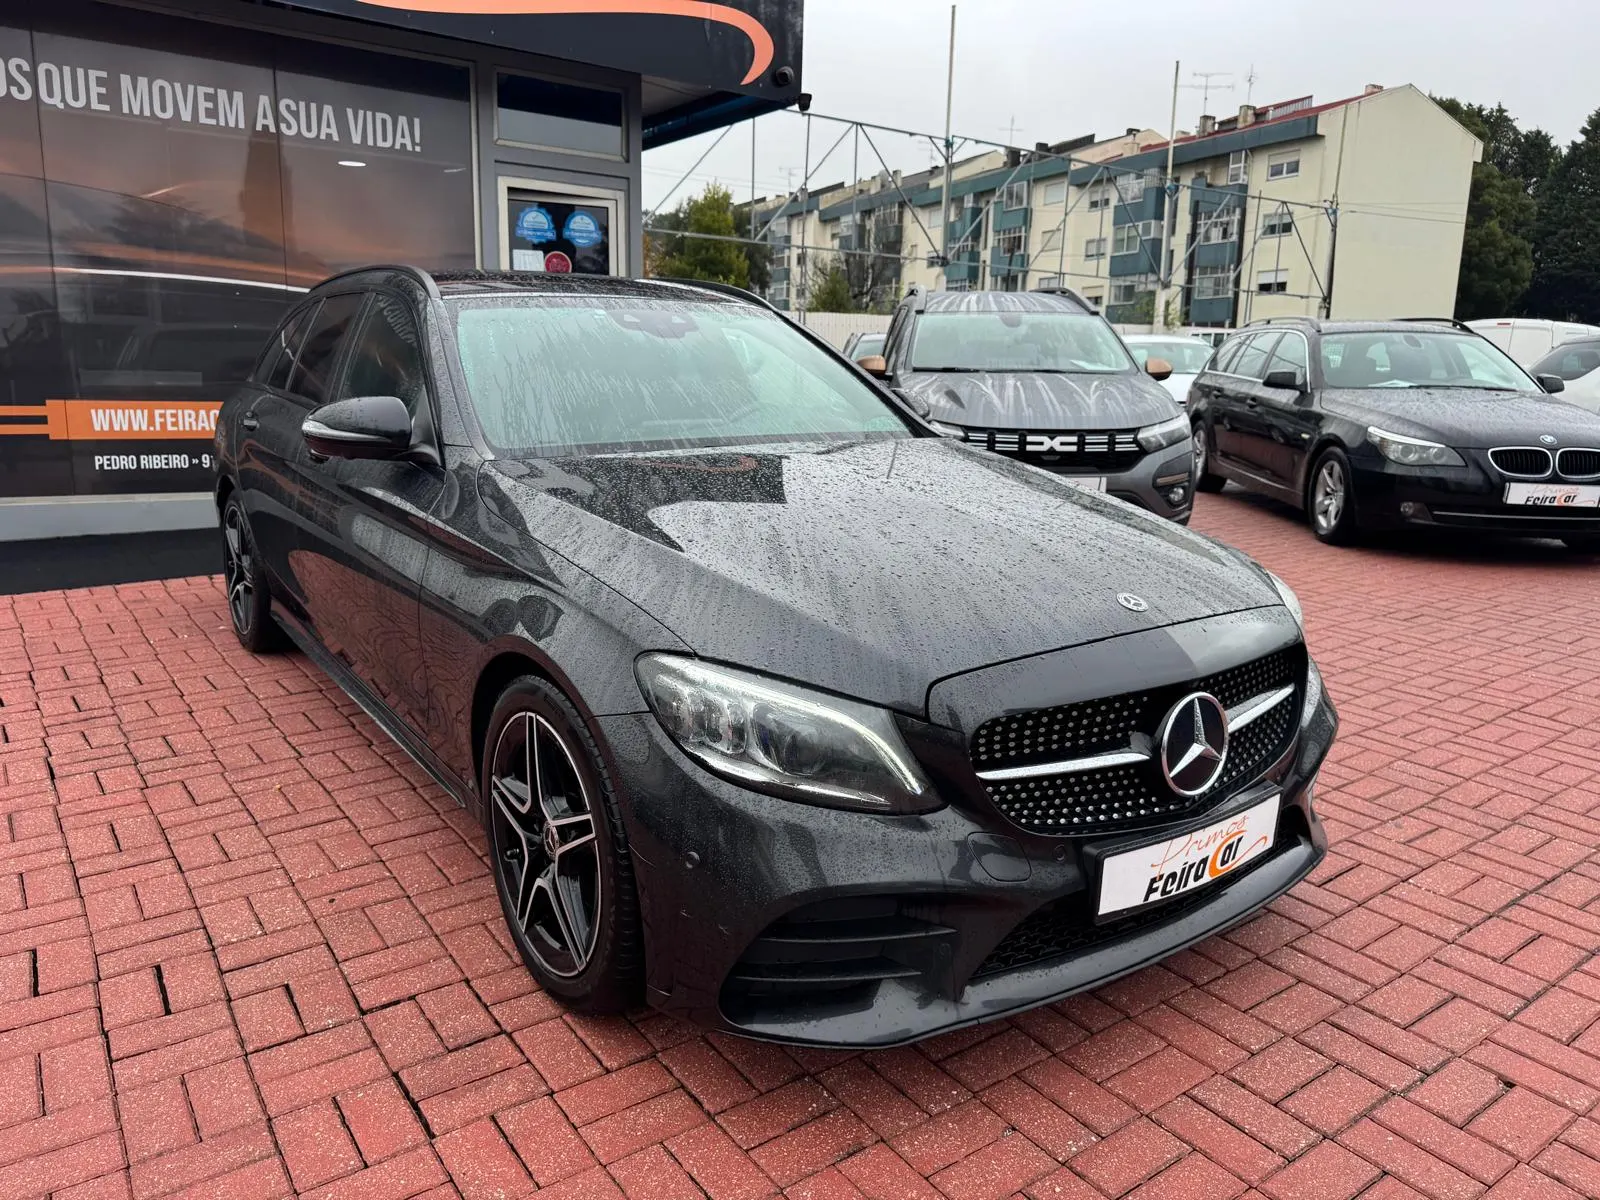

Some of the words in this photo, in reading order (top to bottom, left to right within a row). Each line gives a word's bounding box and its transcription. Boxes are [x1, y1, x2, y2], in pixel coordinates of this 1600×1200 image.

[38, 62, 111, 112] QUE
[120, 73, 246, 129] MOVEM
[346, 107, 422, 153] VIDA!
[94, 455, 137, 470] PEDRO
[140, 454, 189, 469] RIBEIRO
[1143, 829, 1268, 902] FeiraCar
